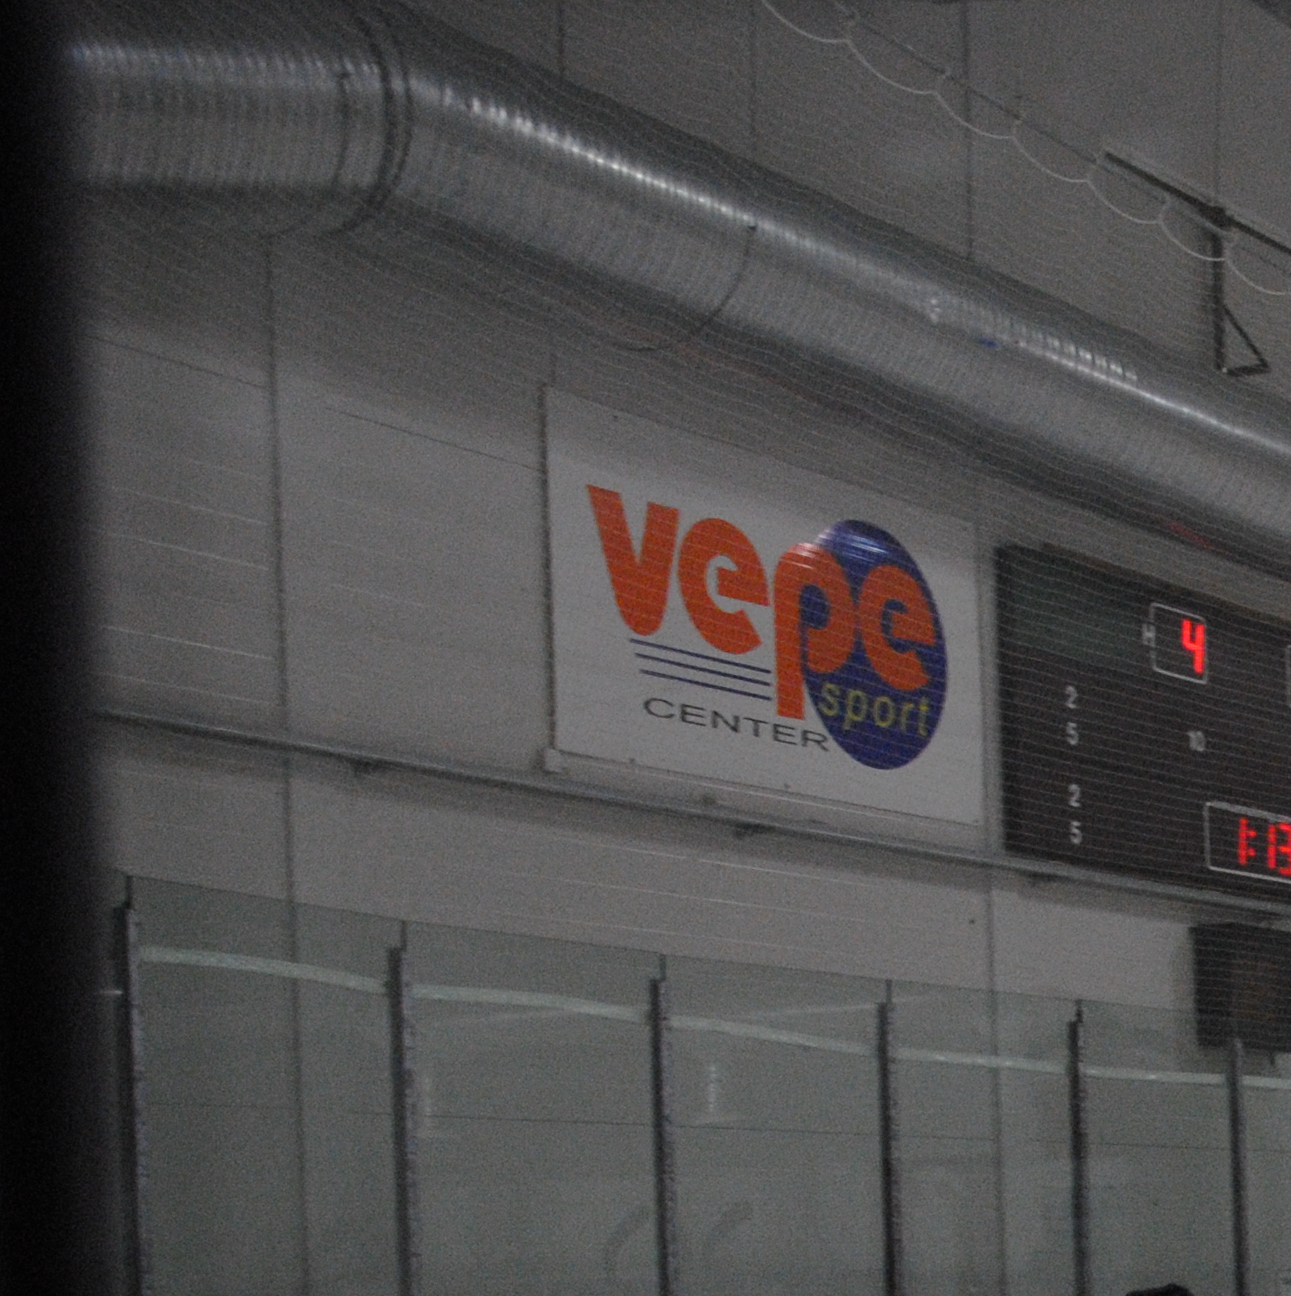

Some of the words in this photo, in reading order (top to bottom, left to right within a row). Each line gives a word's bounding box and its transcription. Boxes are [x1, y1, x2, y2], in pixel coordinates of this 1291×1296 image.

[586, 484, 935, 721] vepe
[1180, 617, 1206, 675] 4
[820, 682, 930, 737] sport
[1065, 684, 1078, 709] 2
[642, 697, 830, 753] CENTER
[1066, 722, 1080, 746] 5
[1067, 783, 1081, 808] 2
[1070, 820, 1083, 846] 5
